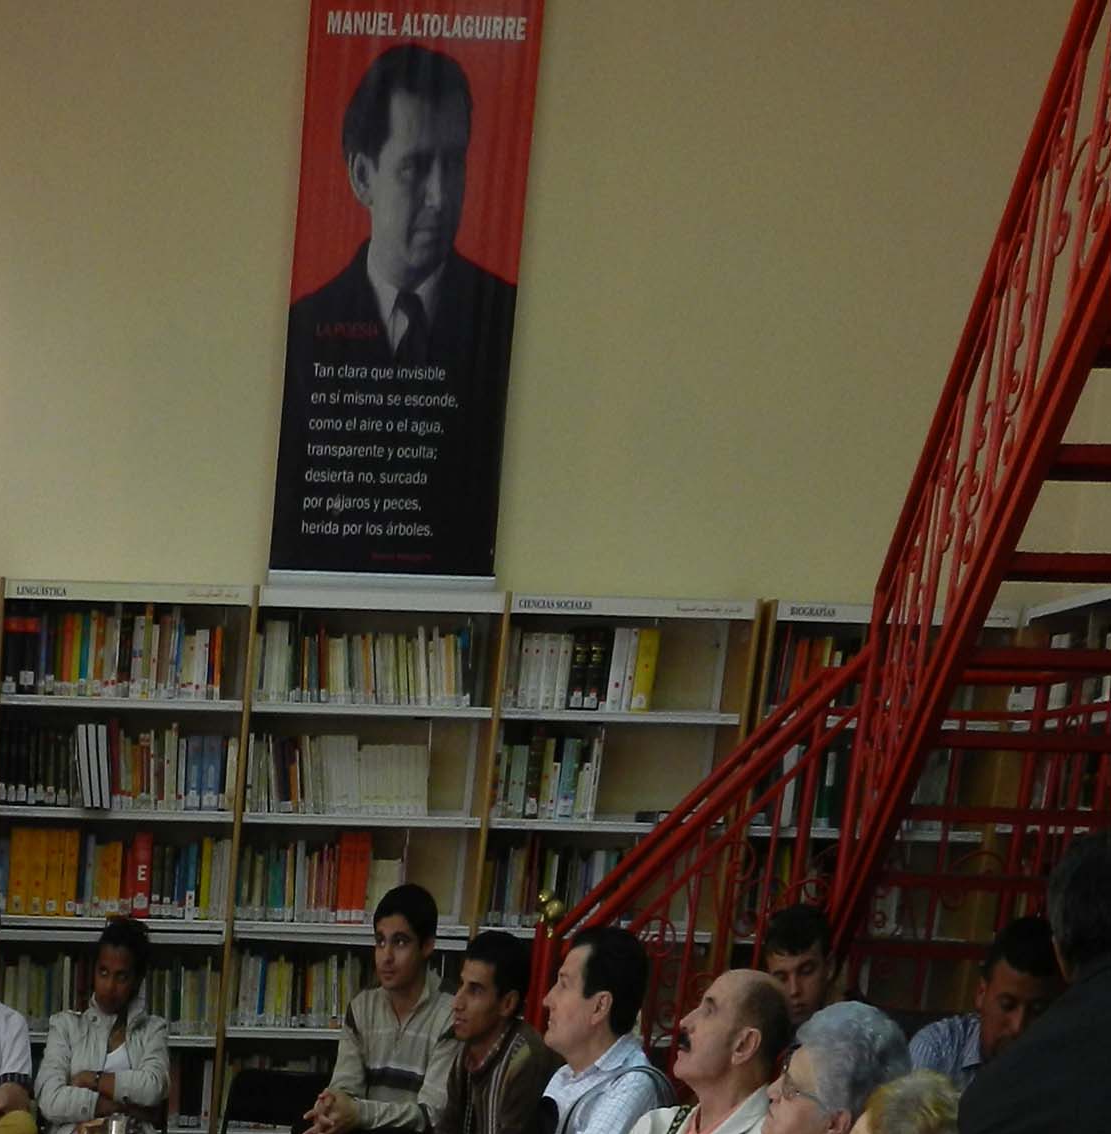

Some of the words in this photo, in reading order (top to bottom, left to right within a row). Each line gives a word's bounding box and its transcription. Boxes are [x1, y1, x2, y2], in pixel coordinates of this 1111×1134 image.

[327, 11, 396, 36] MANUEL
[400, 13, 527, 40] ALTOLAGUIRRE
[314, 362, 334, 378] Tan
[338, 364, 367, 378] clara
[371, 366, 394, 381] que
[397, 365, 446, 381] invisible
[311, 392, 326, 404] en
[343, 391, 383, 405] misma
[387, 394, 401, 406] se
[309, 418, 342, 431] como
[345, 417, 357, 431] el
[359, 418, 383, 432] aire
[386, 420, 394, 432] o
[397, 418, 408, 432] el
[307, 443, 384, 459] transparente
[387, 447, 394, 461] y
[305, 468, 354, 483] desierta
[380, 470, 427, 484] surcada
[303, 496, 323, 511] por
[373, 498, 380, 512] y
[301, 520, 339, 535] herida
[343, 522, 362, 536] por
[366, 522, 383, 536] los
